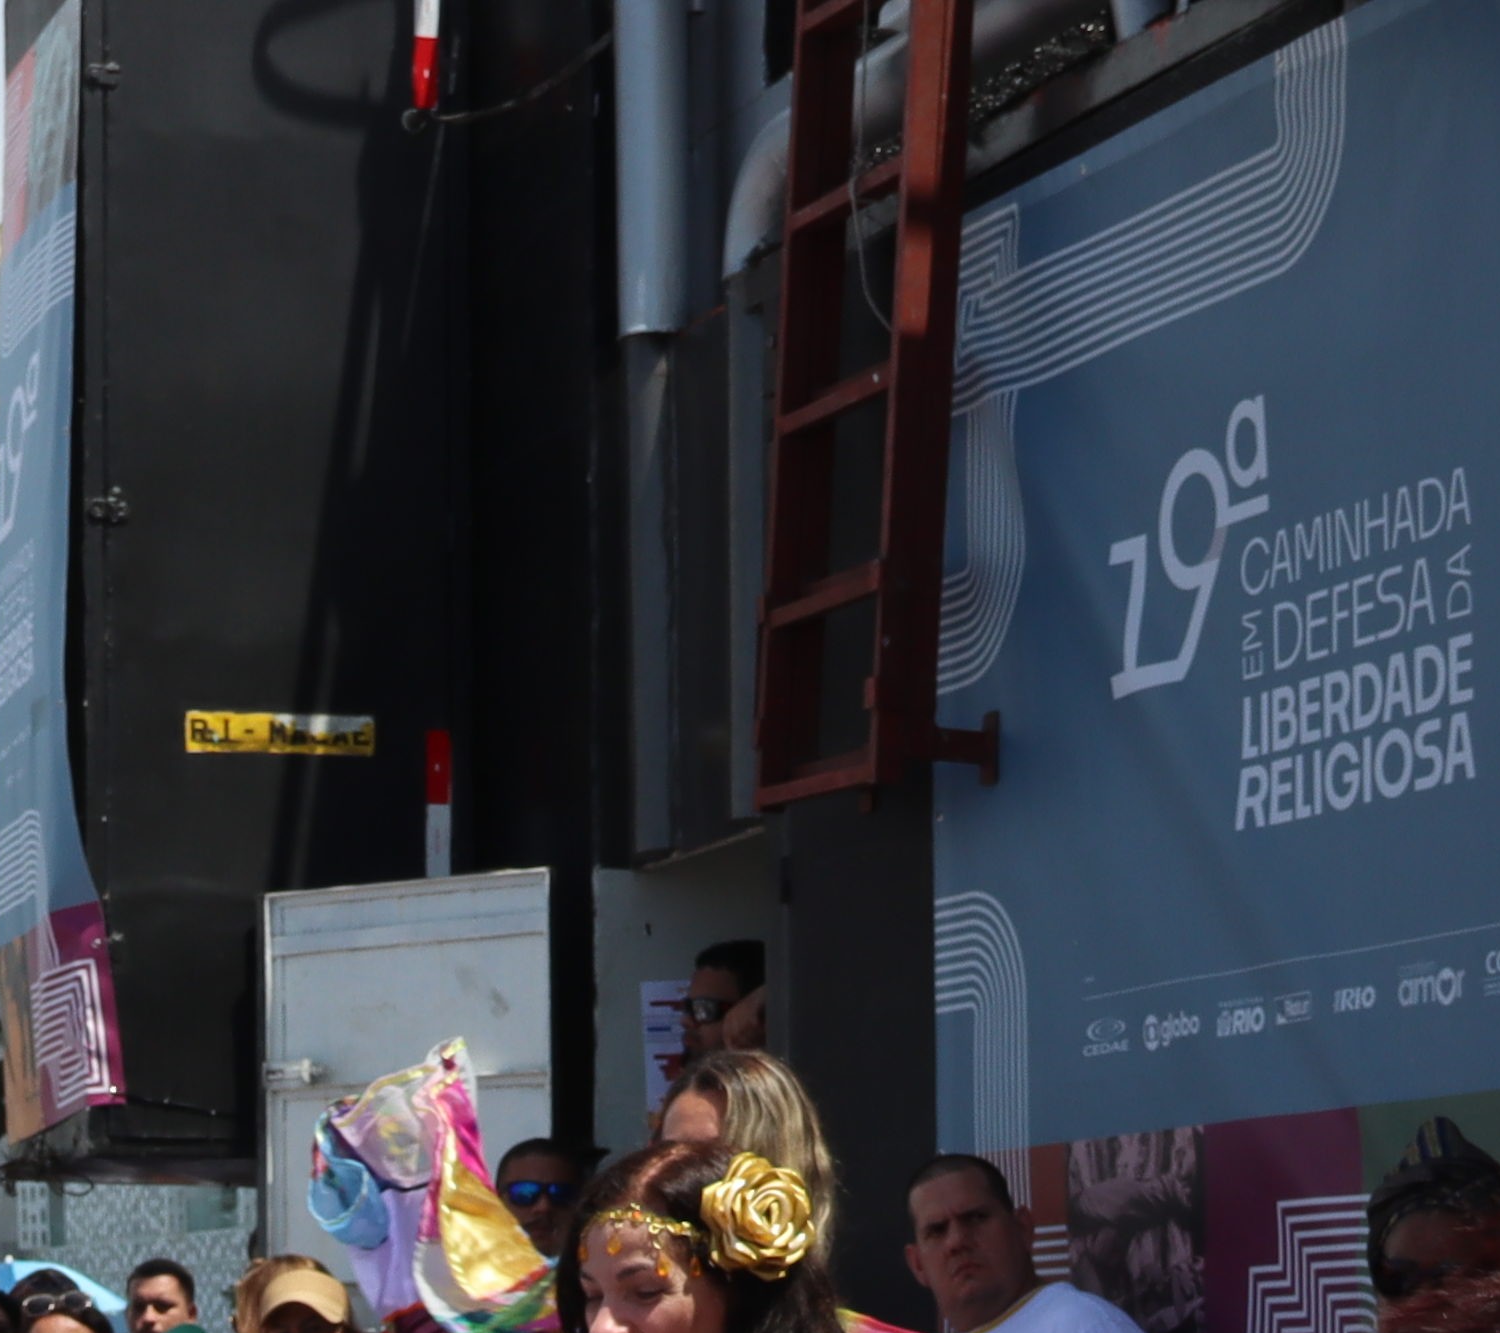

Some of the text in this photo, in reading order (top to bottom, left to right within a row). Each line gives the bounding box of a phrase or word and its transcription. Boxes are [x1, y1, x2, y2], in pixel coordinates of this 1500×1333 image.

[1240, 466, 1472, 596] CAMINHADA
[1241, 543, 1474, 681] EM DEFESA DA
[1241, 632, 1475, 761] LIBERDADE
[1234, 711, 1476, 832] RELIGIOSA
[1083, 1039, 1129, 1057] CEDAE
[1161, 1011, 1200, 1047] globo
